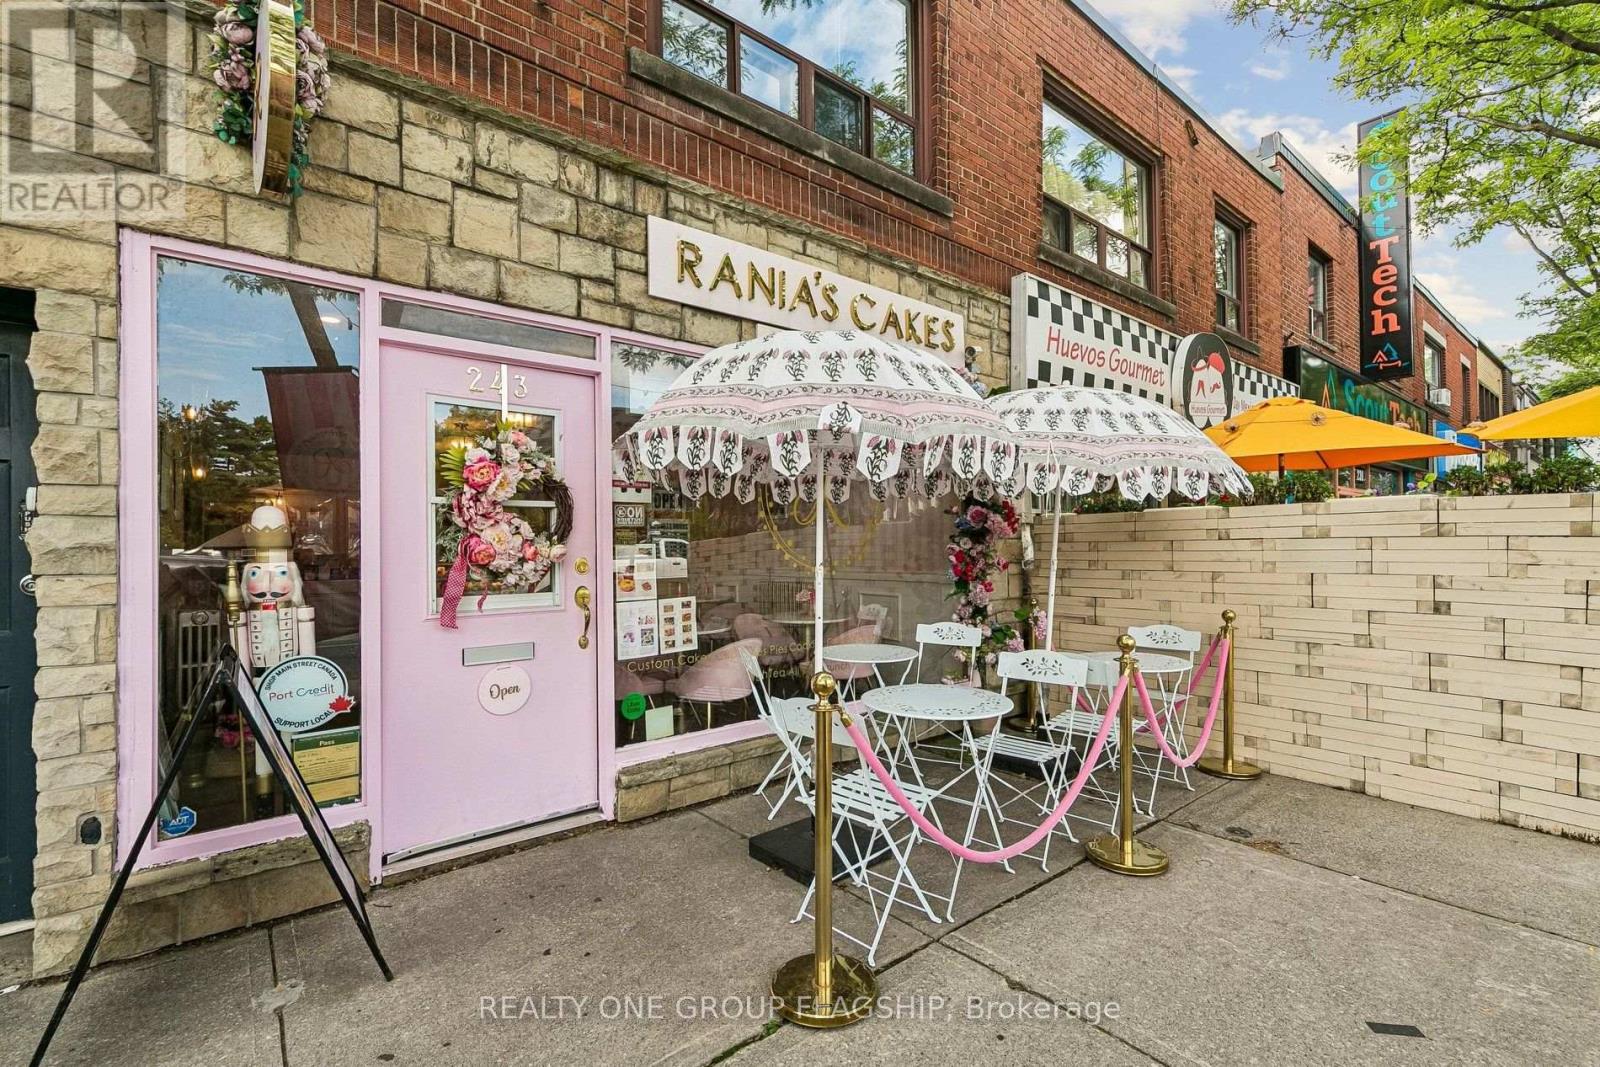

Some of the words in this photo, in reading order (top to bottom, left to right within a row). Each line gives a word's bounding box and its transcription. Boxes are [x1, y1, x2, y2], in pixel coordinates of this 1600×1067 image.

[676, 239, 840, 322] RANIA'S
[850, 293, 956, 353] CAKES
[1046, 326, 1106, 367] Huevos
[1108, 347, 1166, 388] Gourmet
[466, 366, 528, 399] 243
[627, 658, 674, 673] Custom
[264, 675, 277, 691] SHOP
[275, 664, 293, 678] MAIN
[317, 664, 337, 680] CANADA
[269, 690, 294, 702] Port
[296, 683, 336, 697] Credit
[489, 683, 521, 701] Open
[274, 717, 310, 728] SUPPORT
[311, 710, 334, 725] LOCAL
